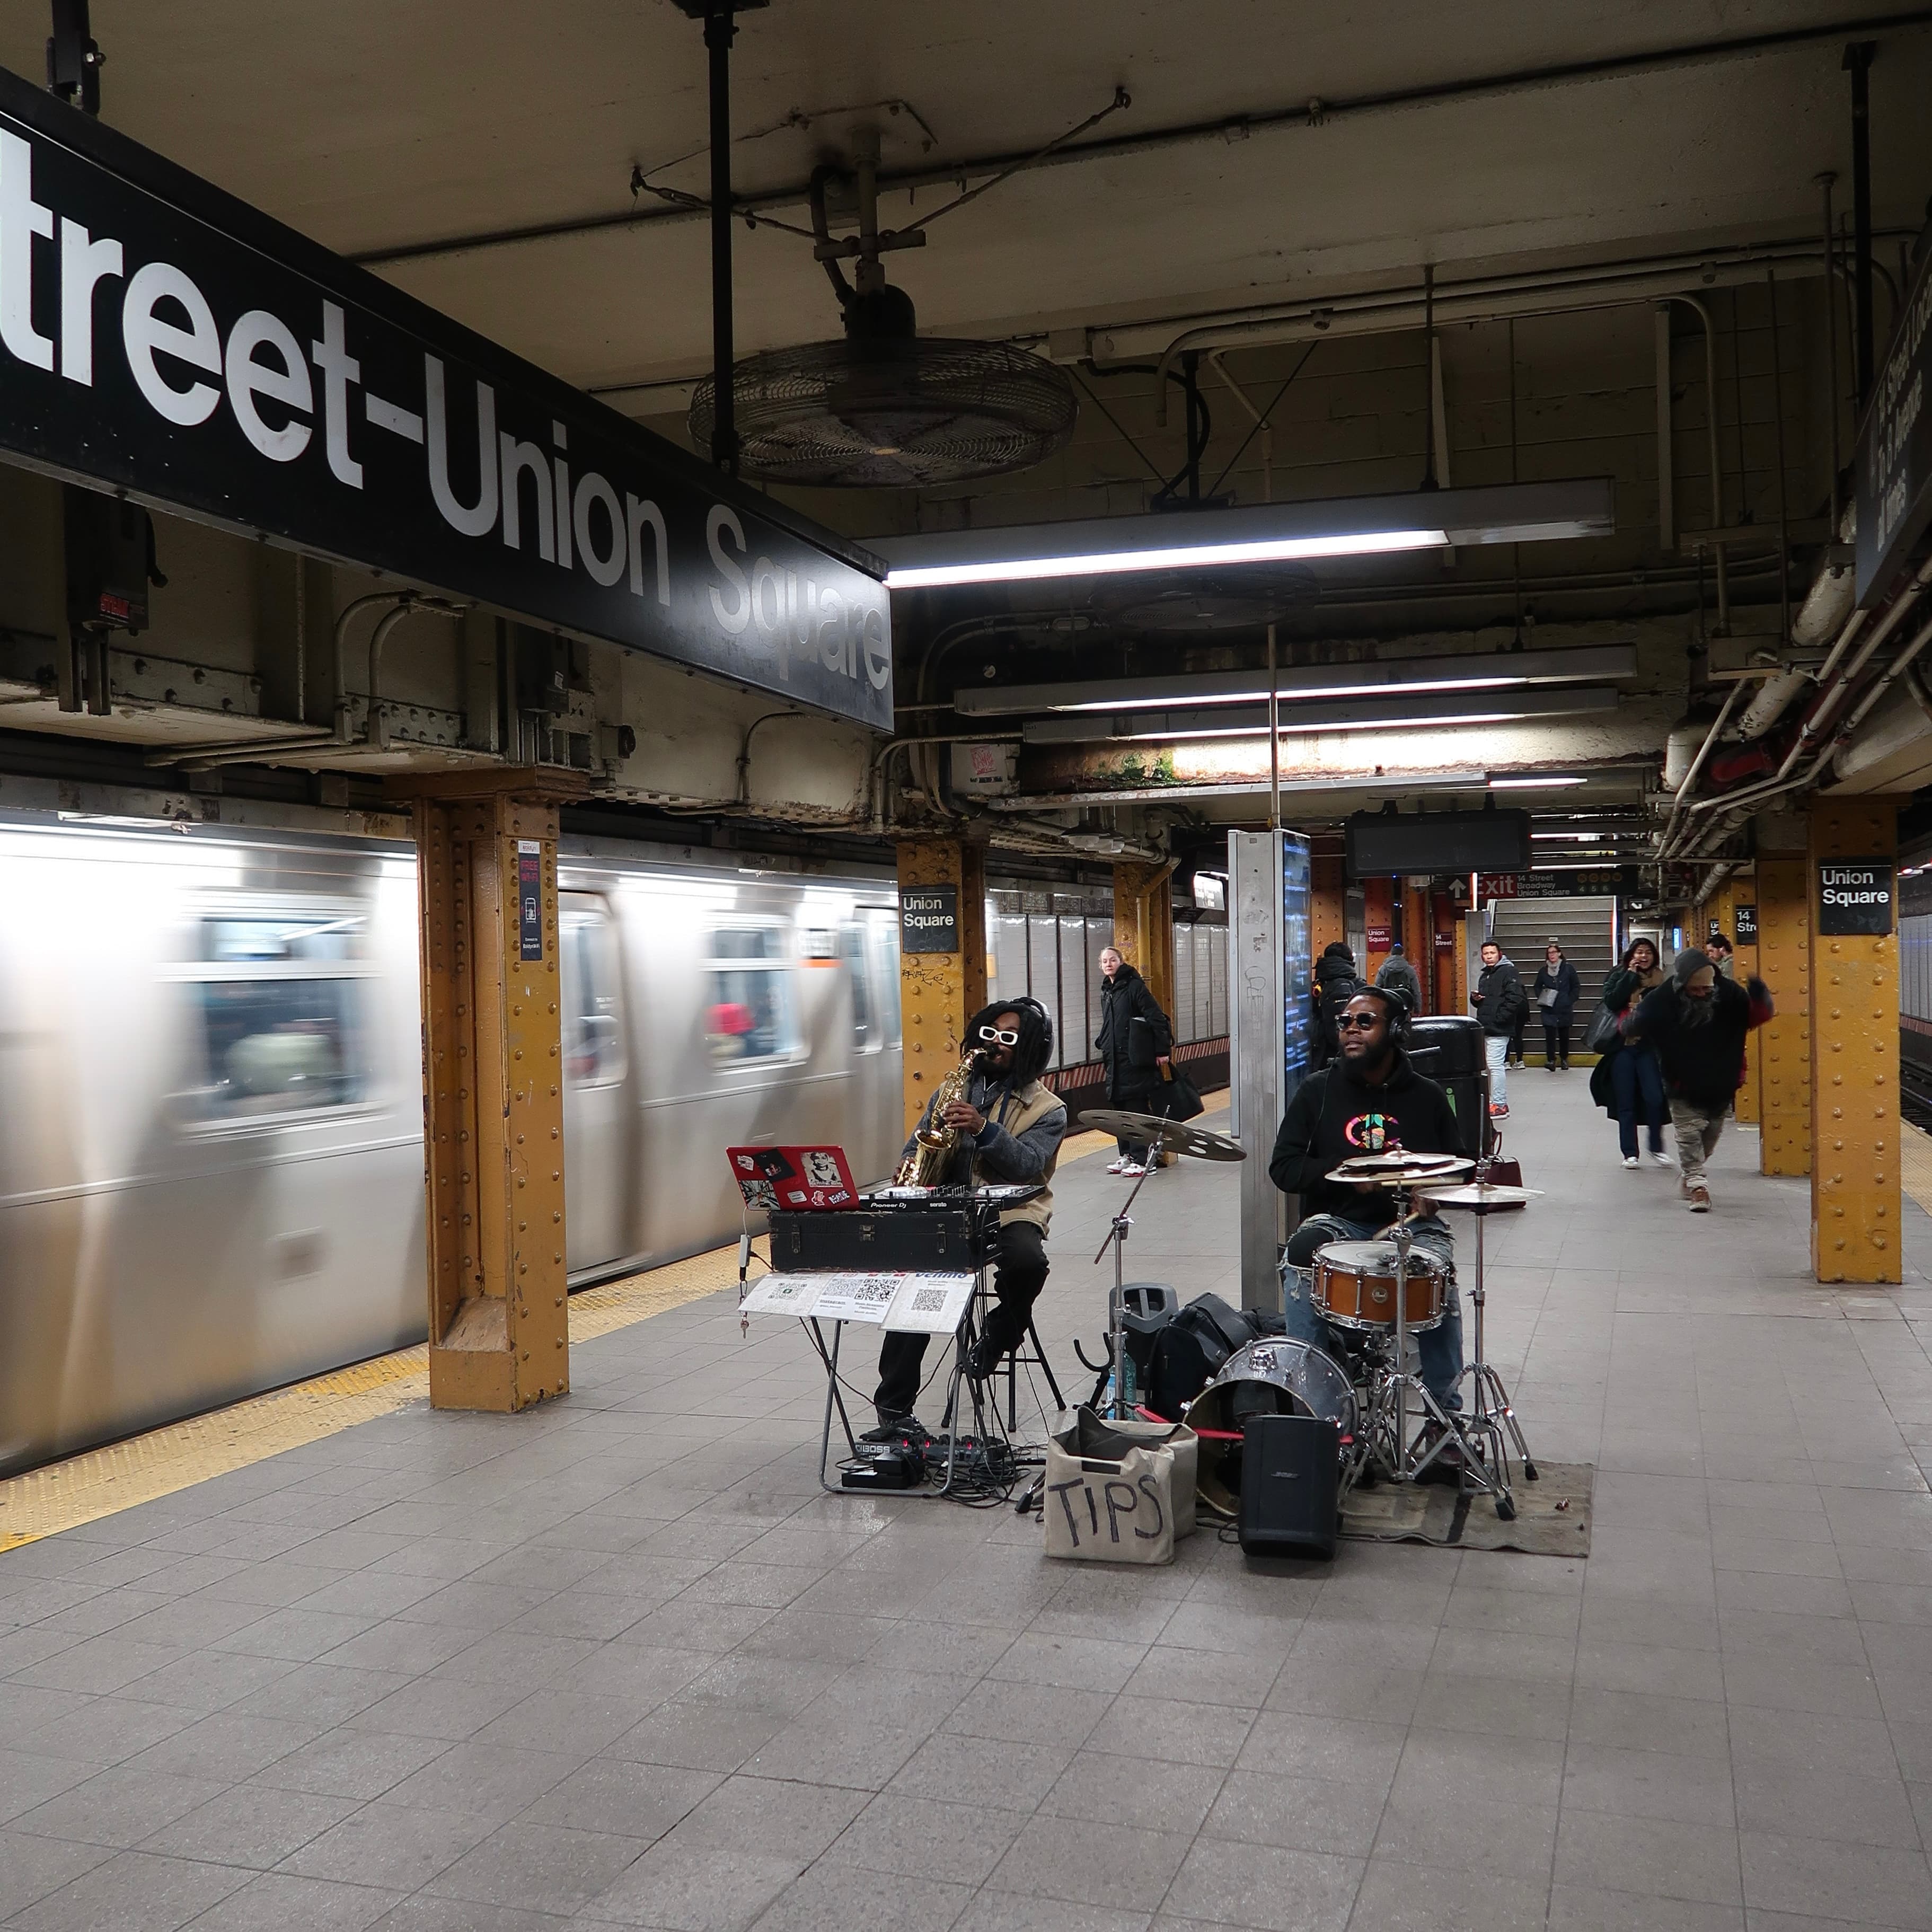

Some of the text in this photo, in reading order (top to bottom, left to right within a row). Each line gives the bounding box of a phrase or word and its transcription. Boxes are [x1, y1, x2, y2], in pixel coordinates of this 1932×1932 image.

[707, 504, 890, 690] Square
[1529, 874, 1554, 882] Street
[1822, 869, 1874, 885] Union
[903, 896, 942, 911] Union
[1822, 888, 1889, 907] Square
[904, 913, 955, 929] Square
[1737, 911, 1751, 921] 14
[862, 1444, 891, 1453] BOSS
[1048, 1474, 1163, 1548] TIPS
